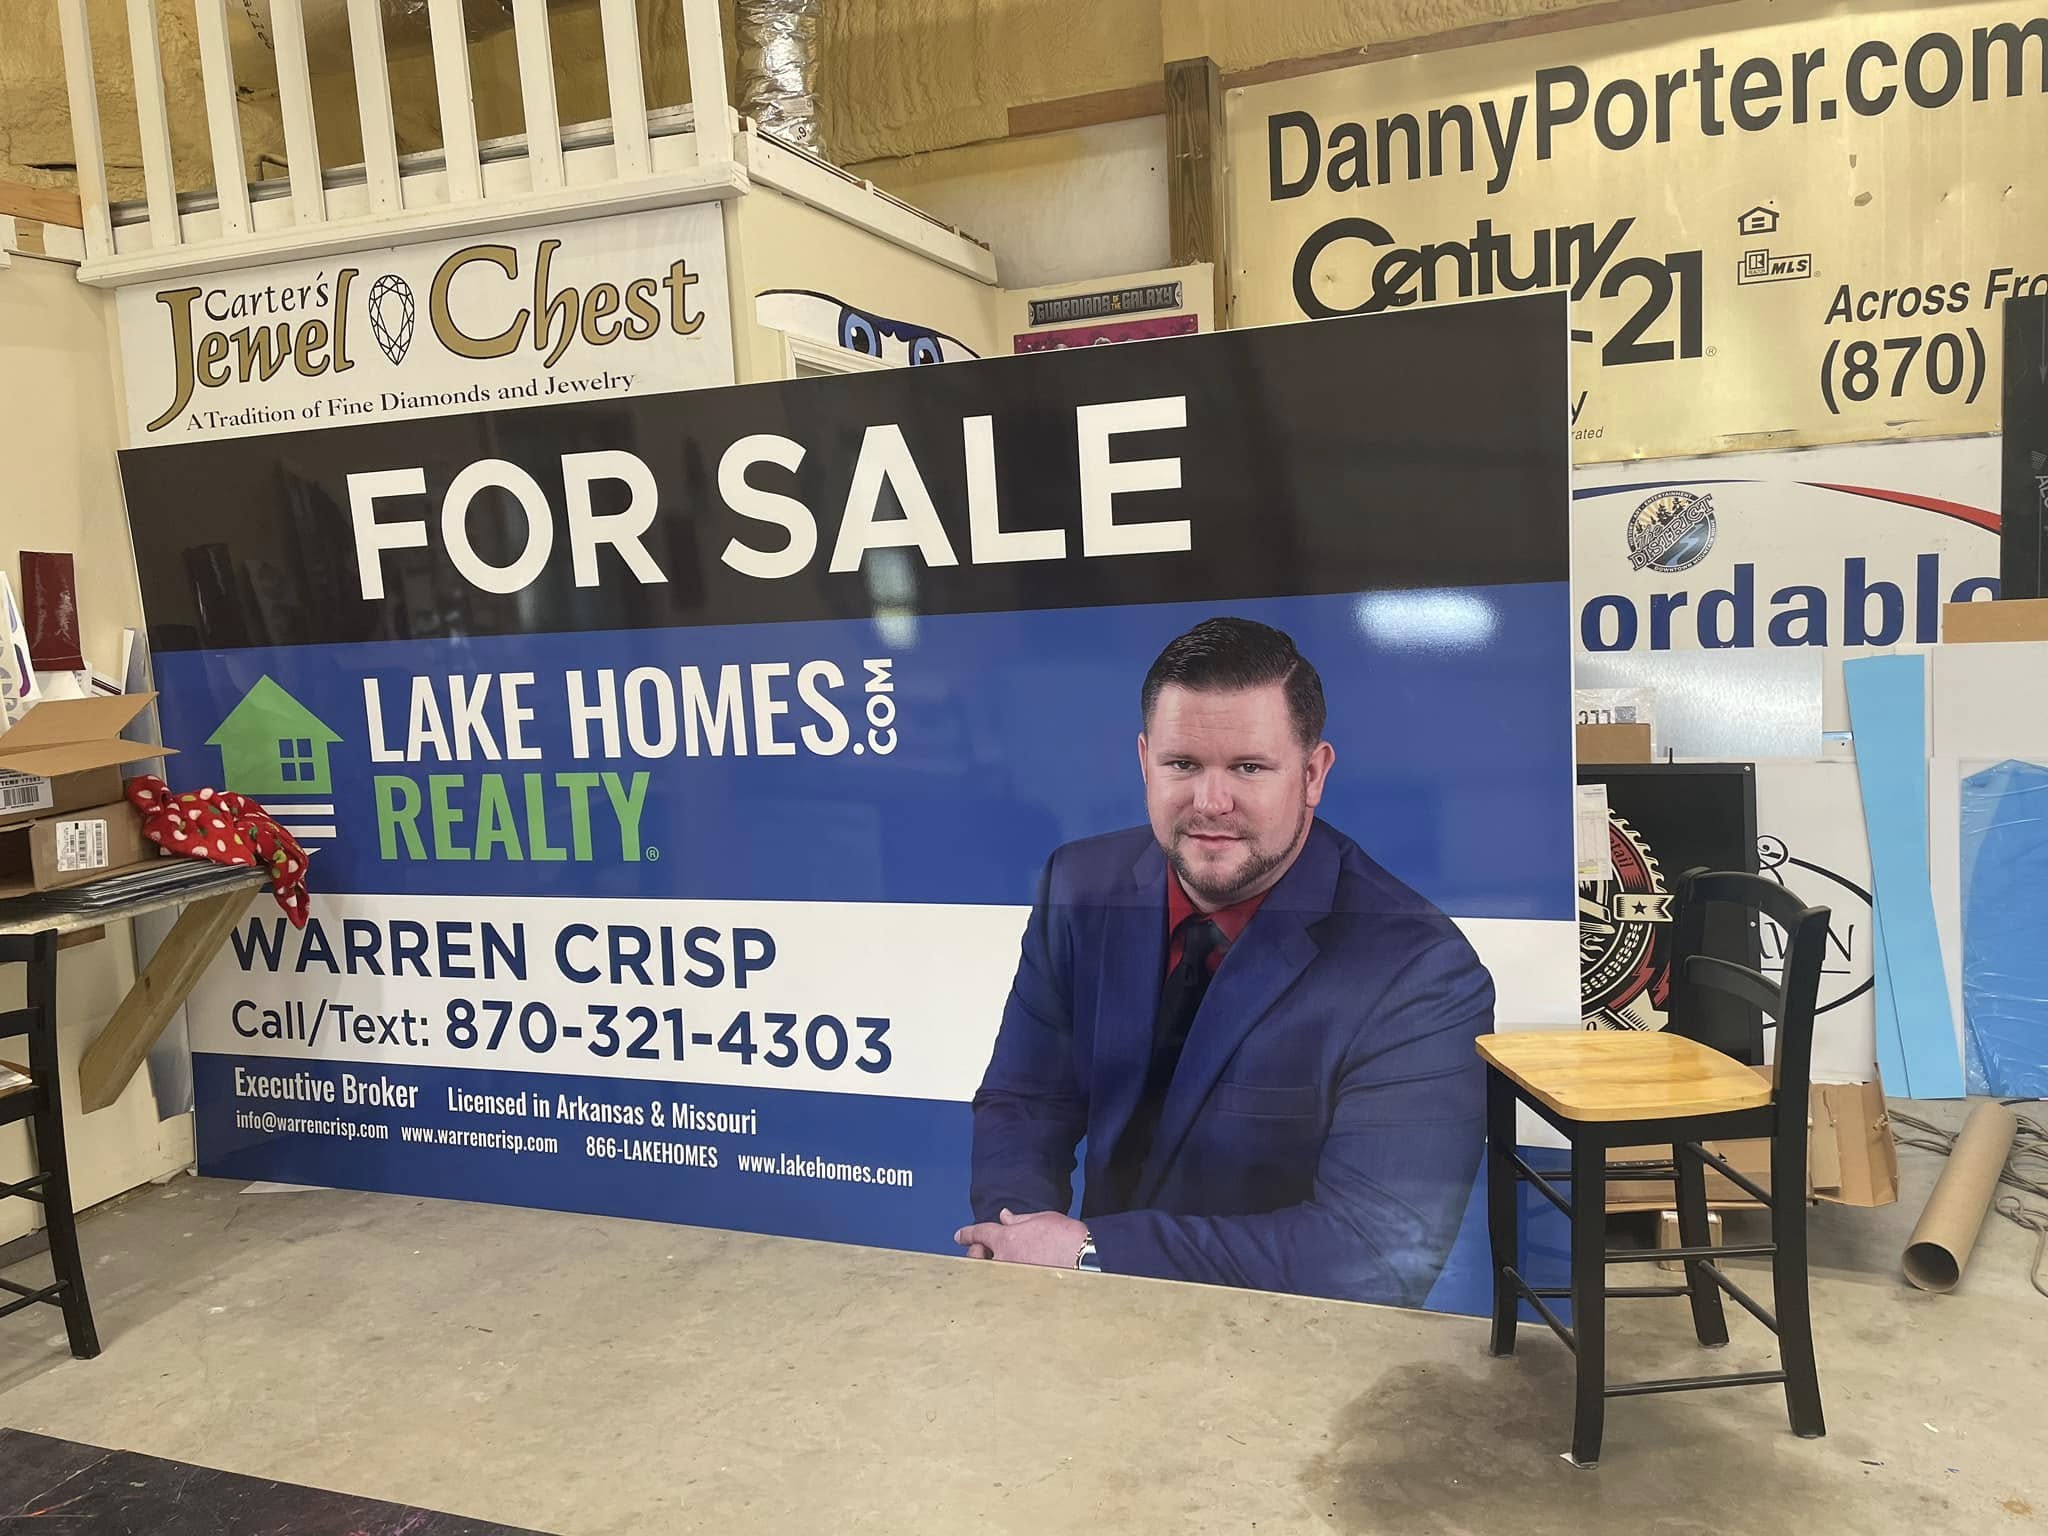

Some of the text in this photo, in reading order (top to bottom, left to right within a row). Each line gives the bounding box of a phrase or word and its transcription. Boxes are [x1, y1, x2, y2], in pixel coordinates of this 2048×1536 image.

[1269, 17, 2048, 200] DannyPorter.com
[205, 271, 329, 322] Carter's
[1036, 295, 1111, 322] GUARDIANS
[1121, 286, 1173, 310] GALAXY
[1293, 217, 1636, 320] Century
[1771, 260, 1808, 275] MLS
[1824, 282, 1970, 325] Across
[147, 239, 705, 432] Jewel Chest
[1821, 327, 1987, 414] (870)
[204, 405, 296, 430] Tradition
[302, 401, 322, 418] of
[328, 398, 373, 417] Fine
[380, 384, 490, 411] Diamonds
[498, 378, 538, 400] and
[545, 371, 637, 394] Jewelry
[346, 396, 1192, 600] FOR SALE
[1627, 493, 1714, 572] DISTRICT
[363, 672, 542, 763] LAKE
[230, 916, 777, 990] WARREN CRISP
[231, 998, 893, 1075] Call/Text: 870-321-4303
[234, 1066, 757, 1135] Executive Broker Licensed in Arkansas & Missouri
[236, 1109, 913, 1188] info@warrencrisp.com www.warrencrisp.com 866-LAKEHOMES www.lakehomes.com
